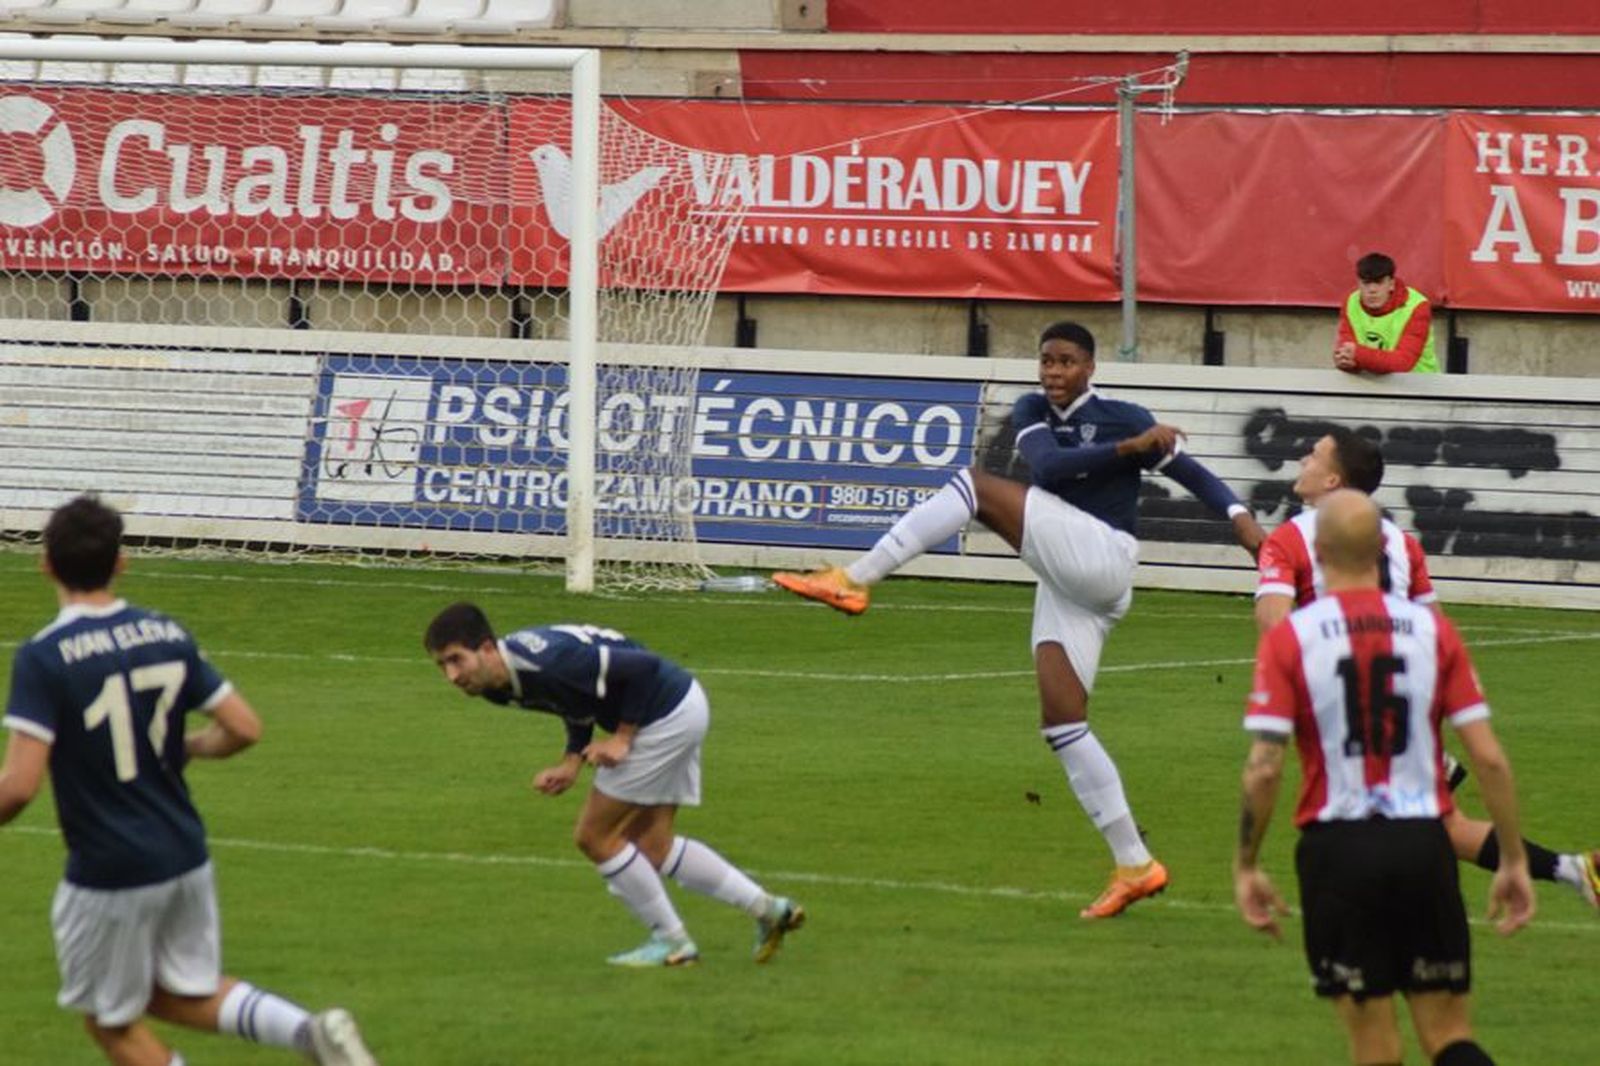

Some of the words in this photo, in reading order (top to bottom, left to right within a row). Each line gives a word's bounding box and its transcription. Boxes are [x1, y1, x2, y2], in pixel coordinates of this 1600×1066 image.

[100, 119, 454, 223] Cualtis
[687, 139, 1092, 215] VALDÉRADUEY
[1476, 131, 1600, 176] HER
[0, 236, 133, 261] VENCIÓN.
[147, 243, 239, 264] SALUD.
[253, 246, 465, 273] TRANQUILIDAD.
[825, 226, 951, 249] COMERCIAL
[967, 230, 992, 250] DE
[1006, 231, 1092, 253] ZAMORA
[423, 467, 571, 508] CENTRO
[592, 475, 813, 519] ZAMORANO
[831, 486, 868, 505] 980
[872, 489, 909, 507] 516
[83, 659, 187, 783] 17
[1335, 655, 1412, 757] 16
